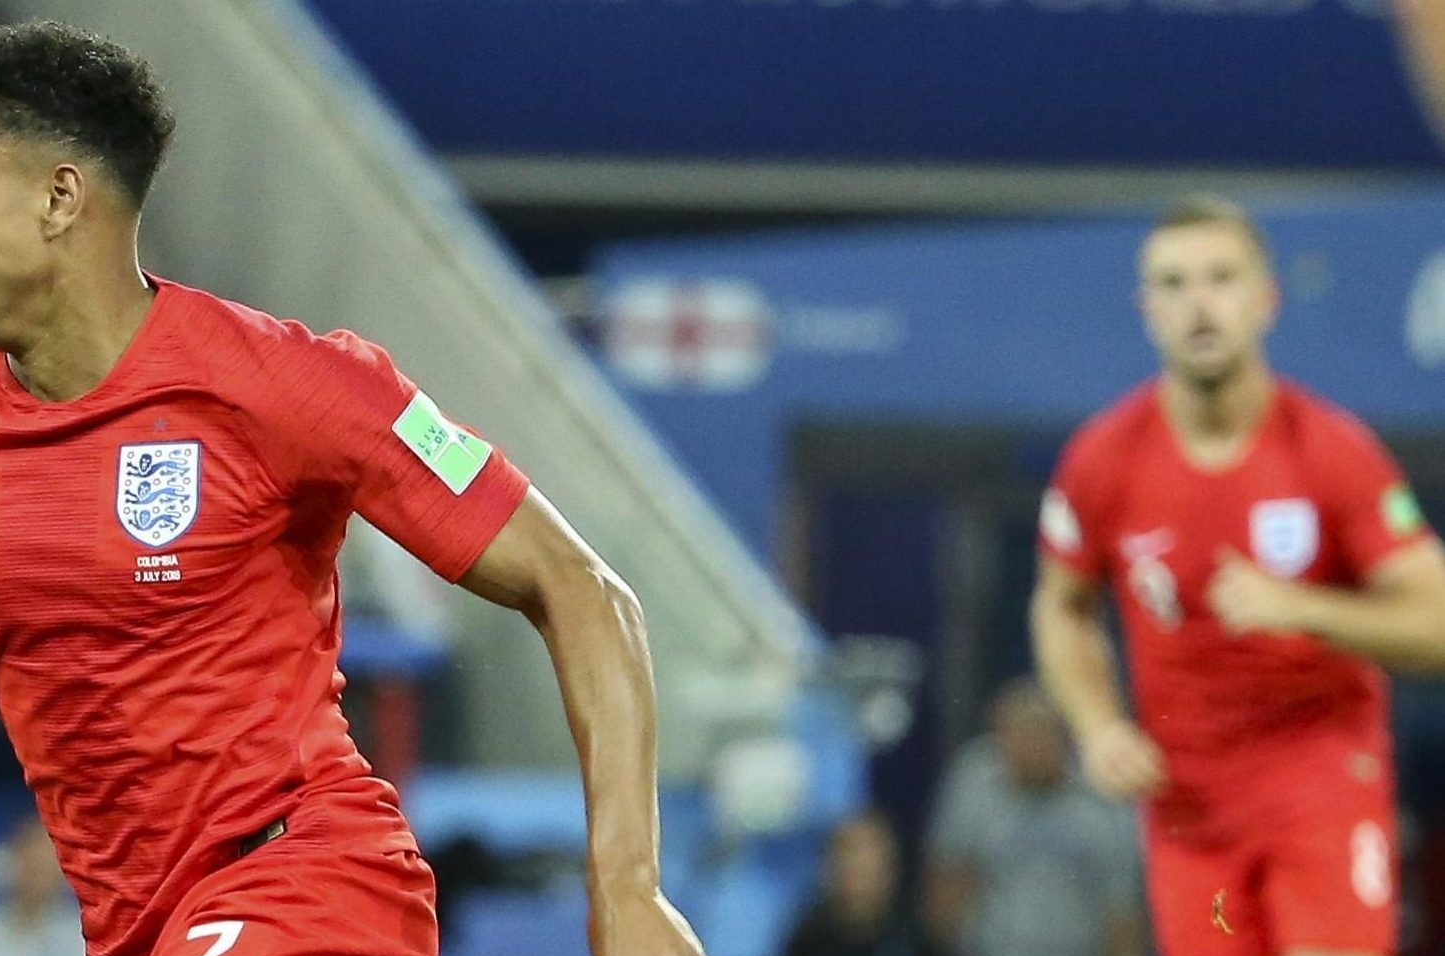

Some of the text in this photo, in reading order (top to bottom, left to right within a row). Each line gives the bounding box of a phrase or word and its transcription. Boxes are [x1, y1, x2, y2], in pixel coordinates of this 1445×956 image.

[136, 555, 179, 568] COLOMBIA
[134, 569, 181, 582] 3 JULY 2018
